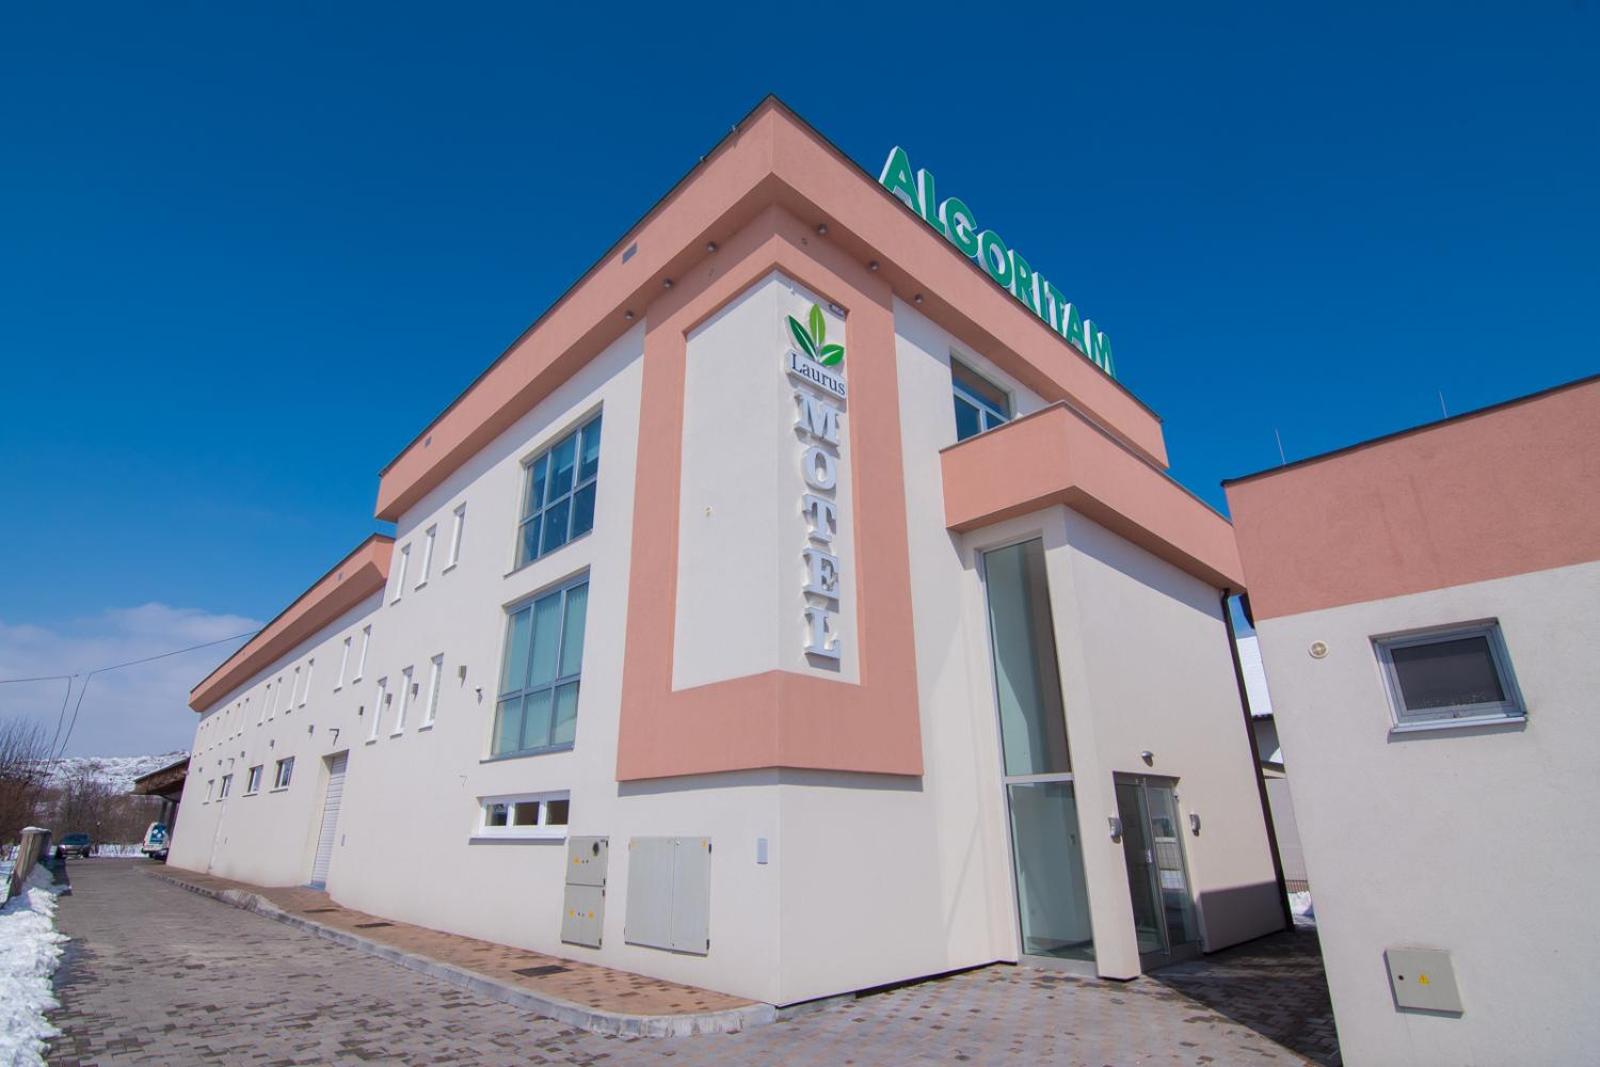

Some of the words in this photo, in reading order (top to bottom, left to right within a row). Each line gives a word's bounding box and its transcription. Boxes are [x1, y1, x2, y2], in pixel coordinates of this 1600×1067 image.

[791, 353, 846, 396] Laurus
[879, 146, 1116, 379] ALGORITAM
[795, 394, 841, 659] MOTEL
